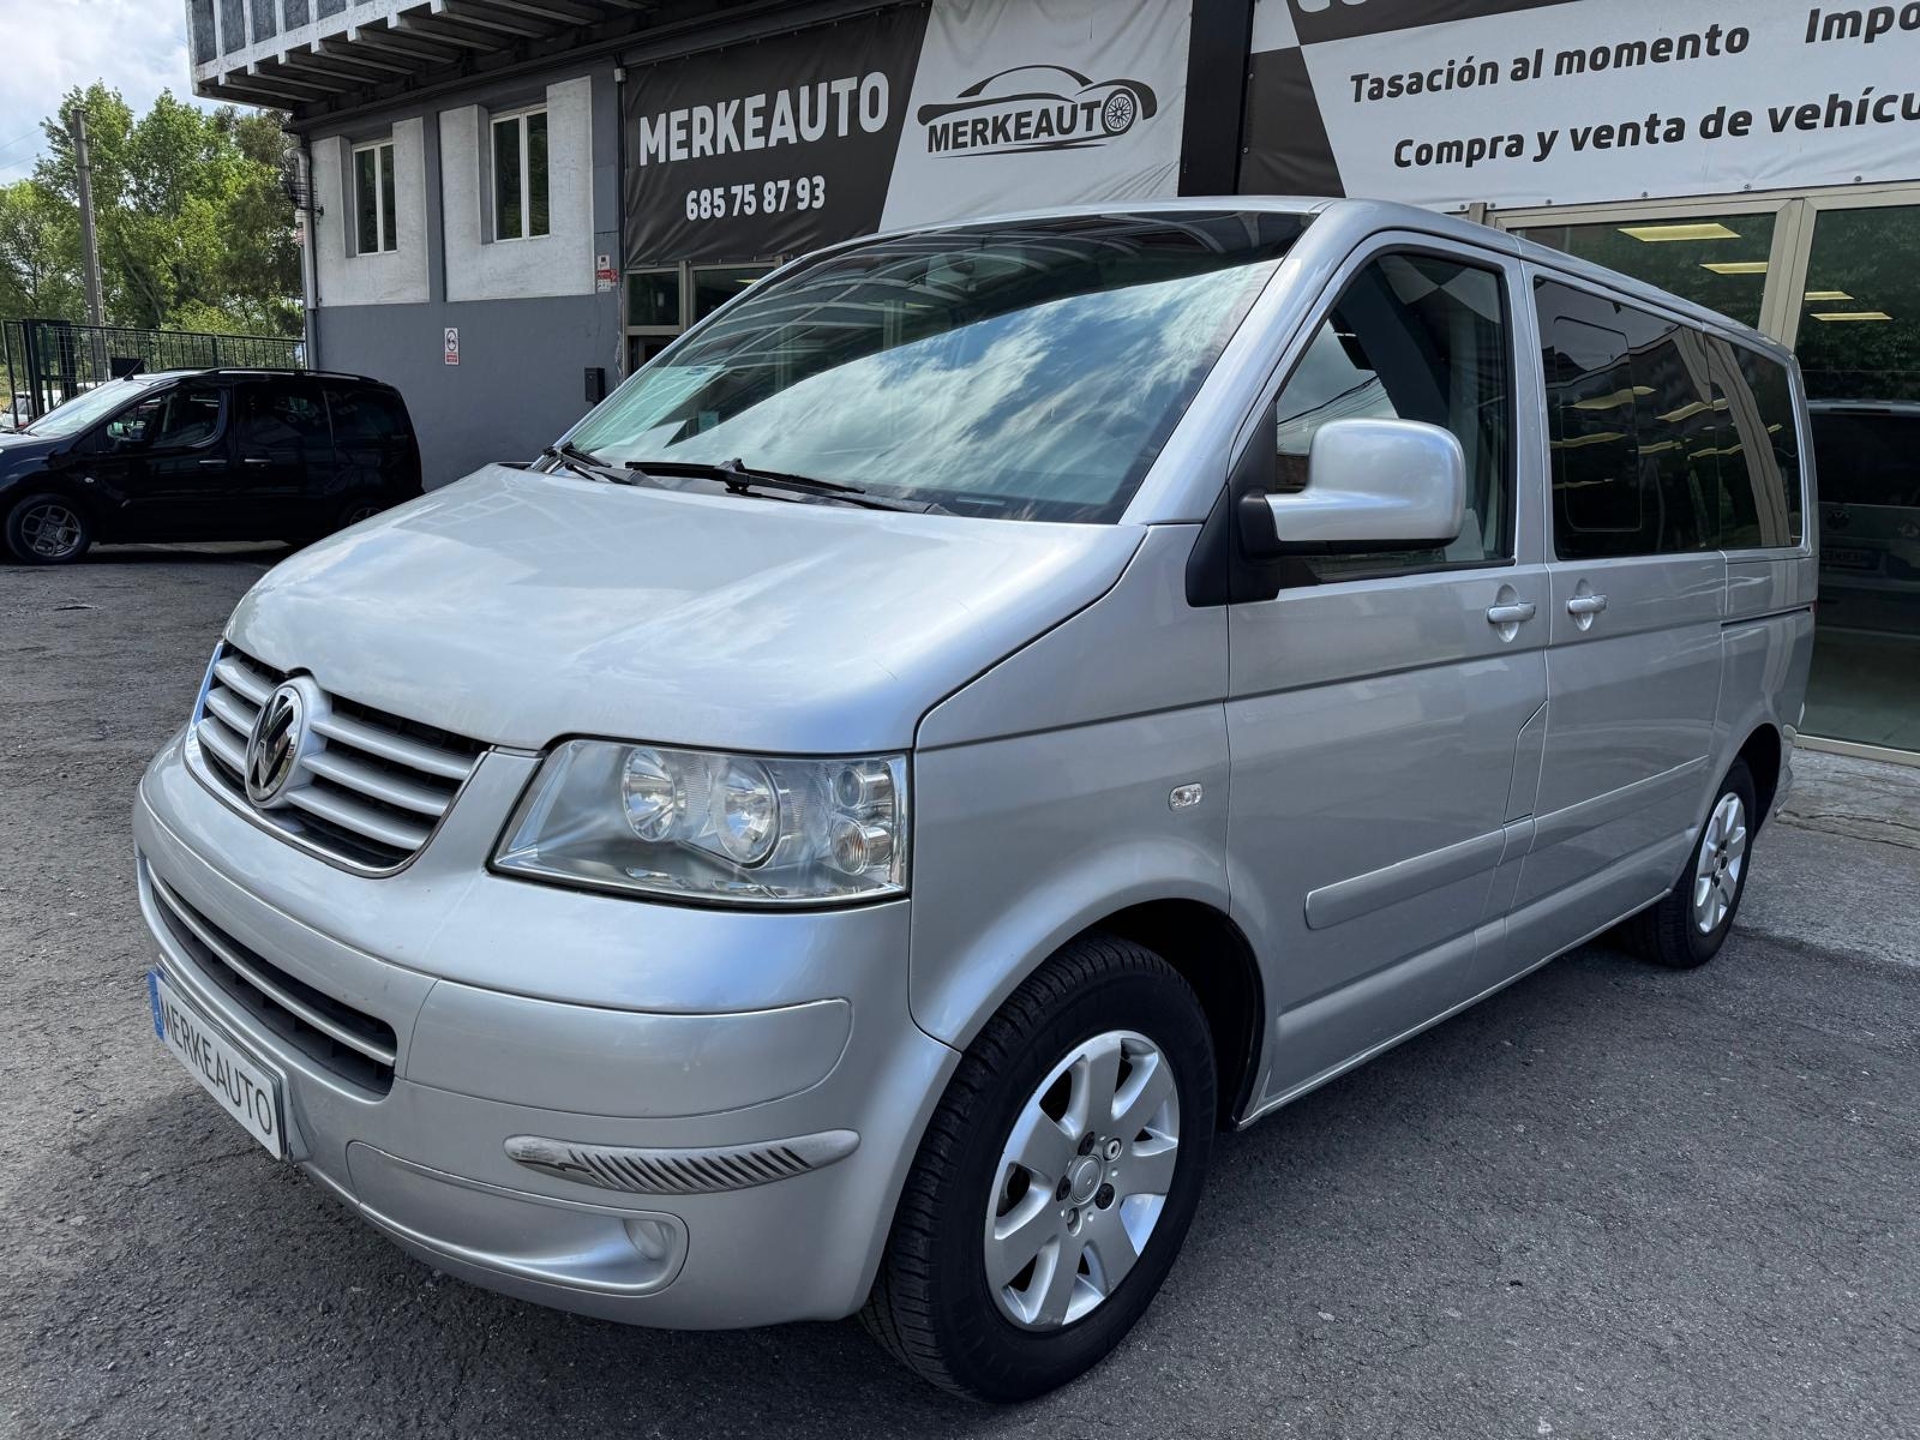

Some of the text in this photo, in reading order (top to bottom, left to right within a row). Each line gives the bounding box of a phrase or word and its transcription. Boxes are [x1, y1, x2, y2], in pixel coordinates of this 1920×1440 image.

[1350, 23, 1750, 103] Tasación al momento
[1805, 1, 1920, 44] Impo
[639, 71, 889, 167] MERKEAUTO
[1393, 86, 1920, 169] Compra y venta de vehícu
[686, 175, 826, 221] 685 75 87 93
[160, 1000, 272, 1136] MERKEAUTO
